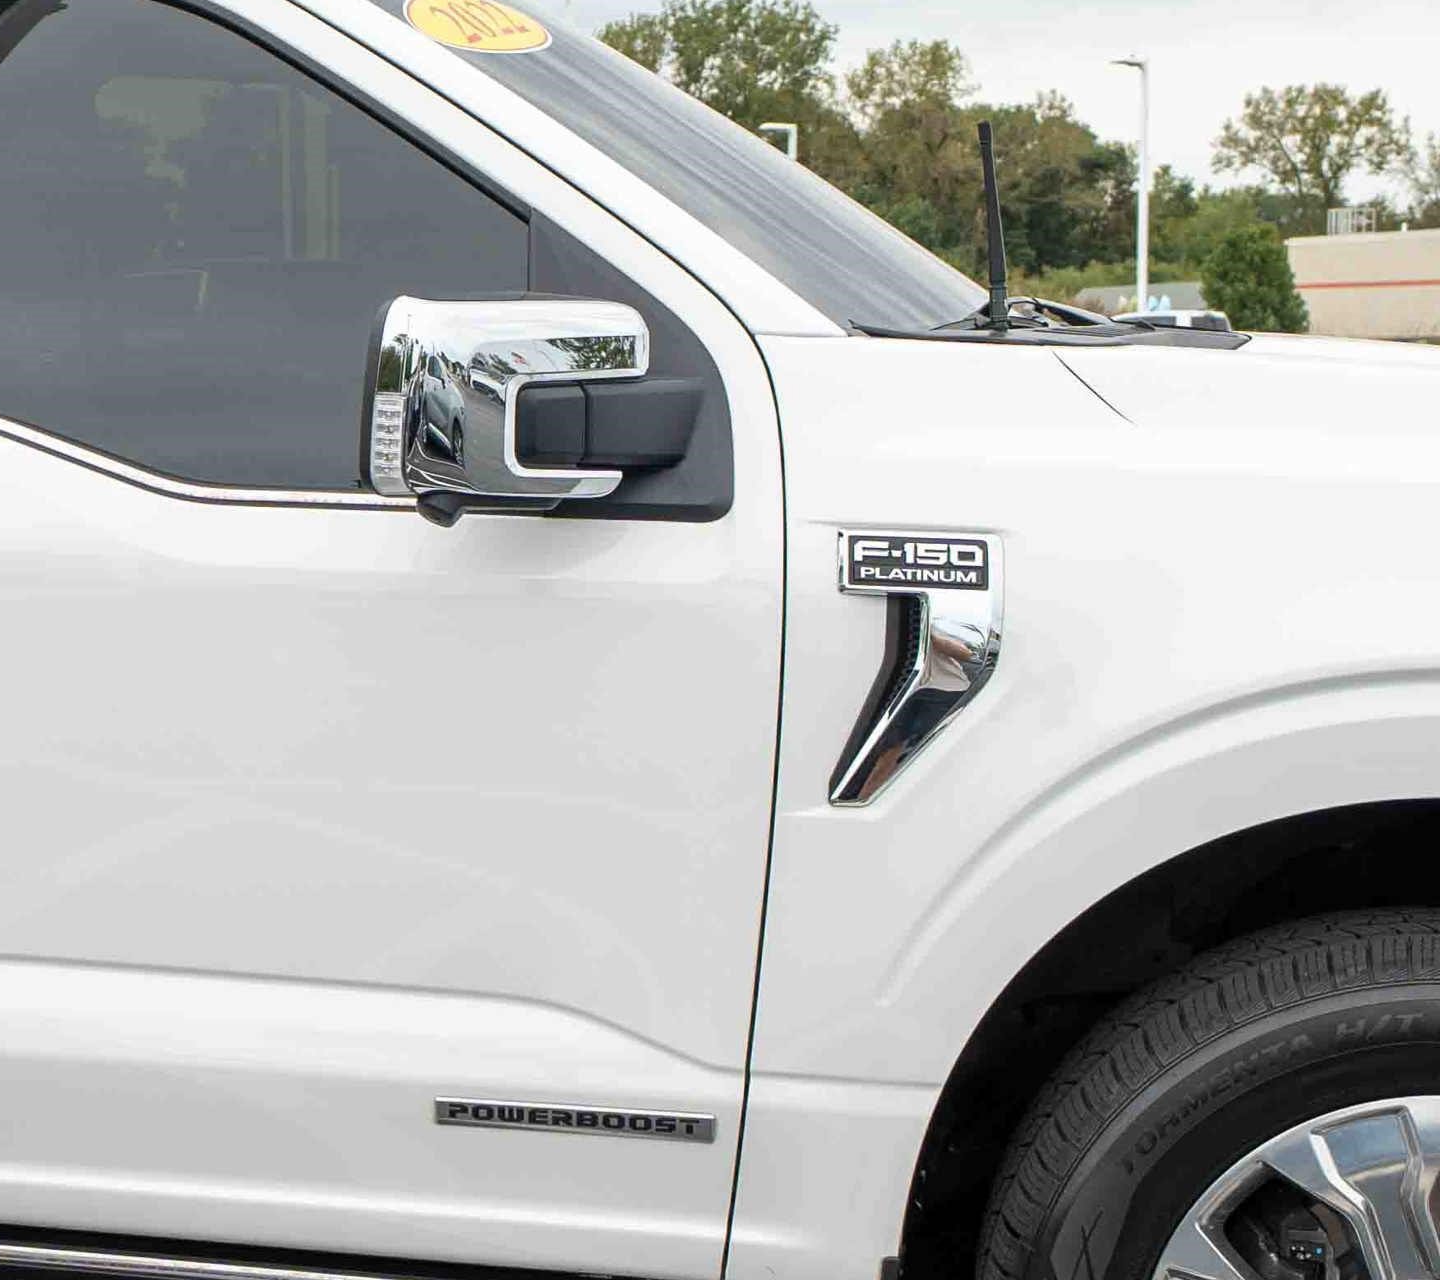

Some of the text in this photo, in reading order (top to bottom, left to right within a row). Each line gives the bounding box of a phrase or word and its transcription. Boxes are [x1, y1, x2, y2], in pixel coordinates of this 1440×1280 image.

[853, 540, 984, 567] F-150
[860, 566, 977, 584] PLATINUM
[448, 1103, 700, 1135] POWERBOOST
